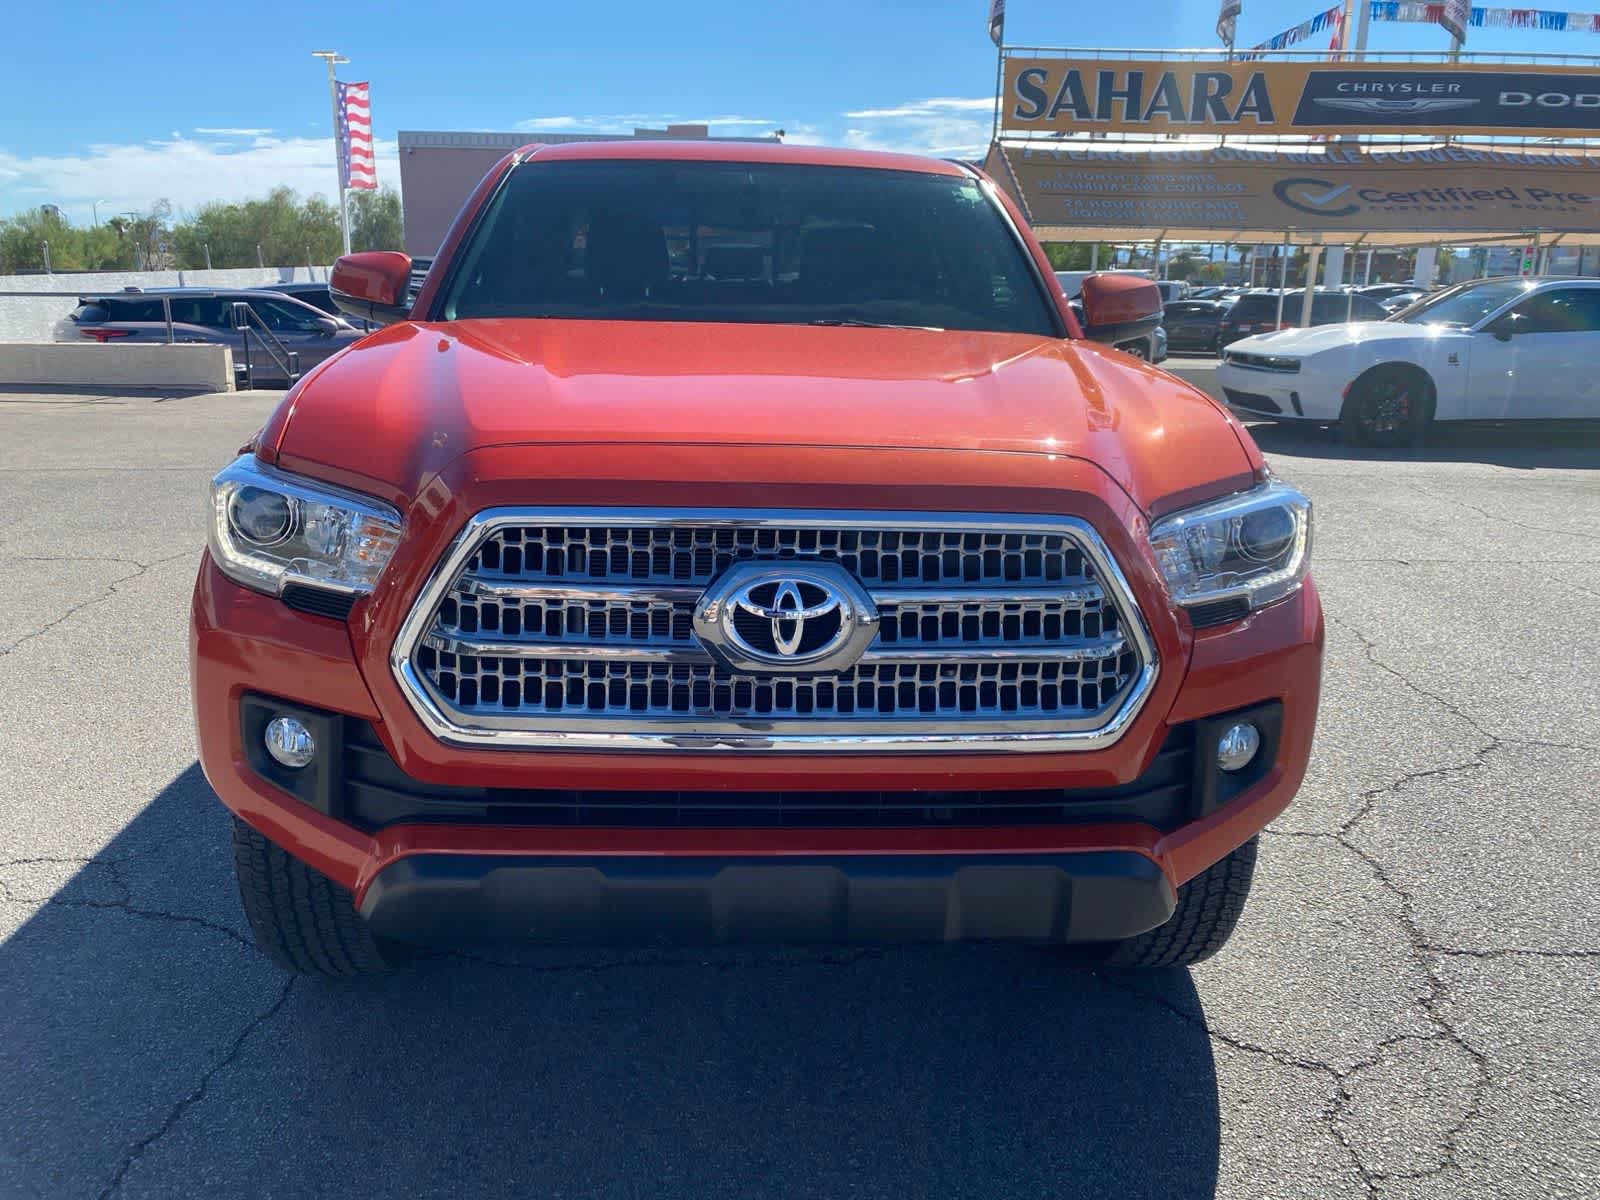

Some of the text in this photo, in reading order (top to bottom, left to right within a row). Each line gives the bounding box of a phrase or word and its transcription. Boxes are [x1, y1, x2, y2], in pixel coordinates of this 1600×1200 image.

[1012, 67, 1276, 125] SAHARA
[1337, 82, 1462, 93] CHRYSLER
[1357, 184, 1519, 203] Certified
